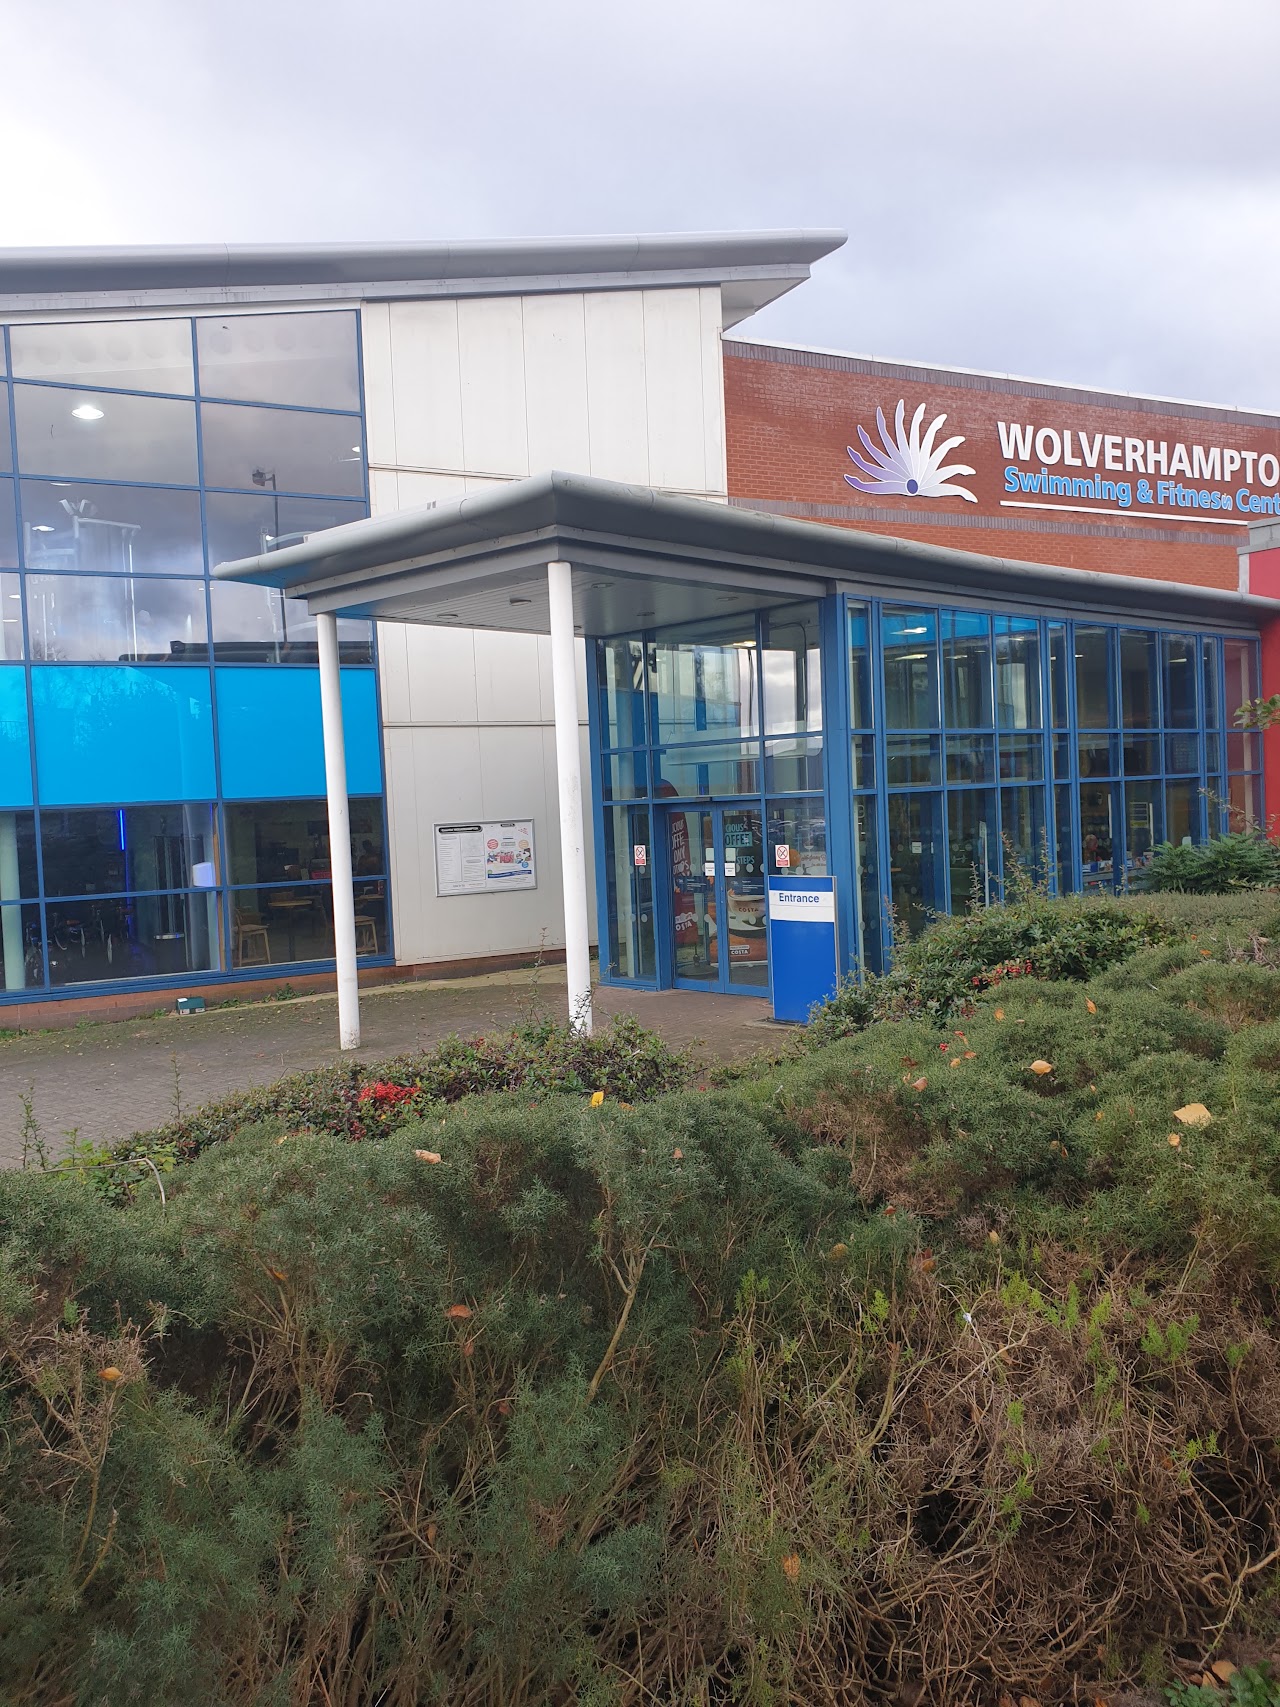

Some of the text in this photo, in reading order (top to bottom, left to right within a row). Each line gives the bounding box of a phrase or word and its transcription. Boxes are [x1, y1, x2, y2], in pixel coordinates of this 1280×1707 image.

[1004, 466, 1132, 506] Swimming
[1136, 478, 1154, 504] &
[736, 855, 755, 864] STEPS
[779, 893, 820, 903] Entrance
